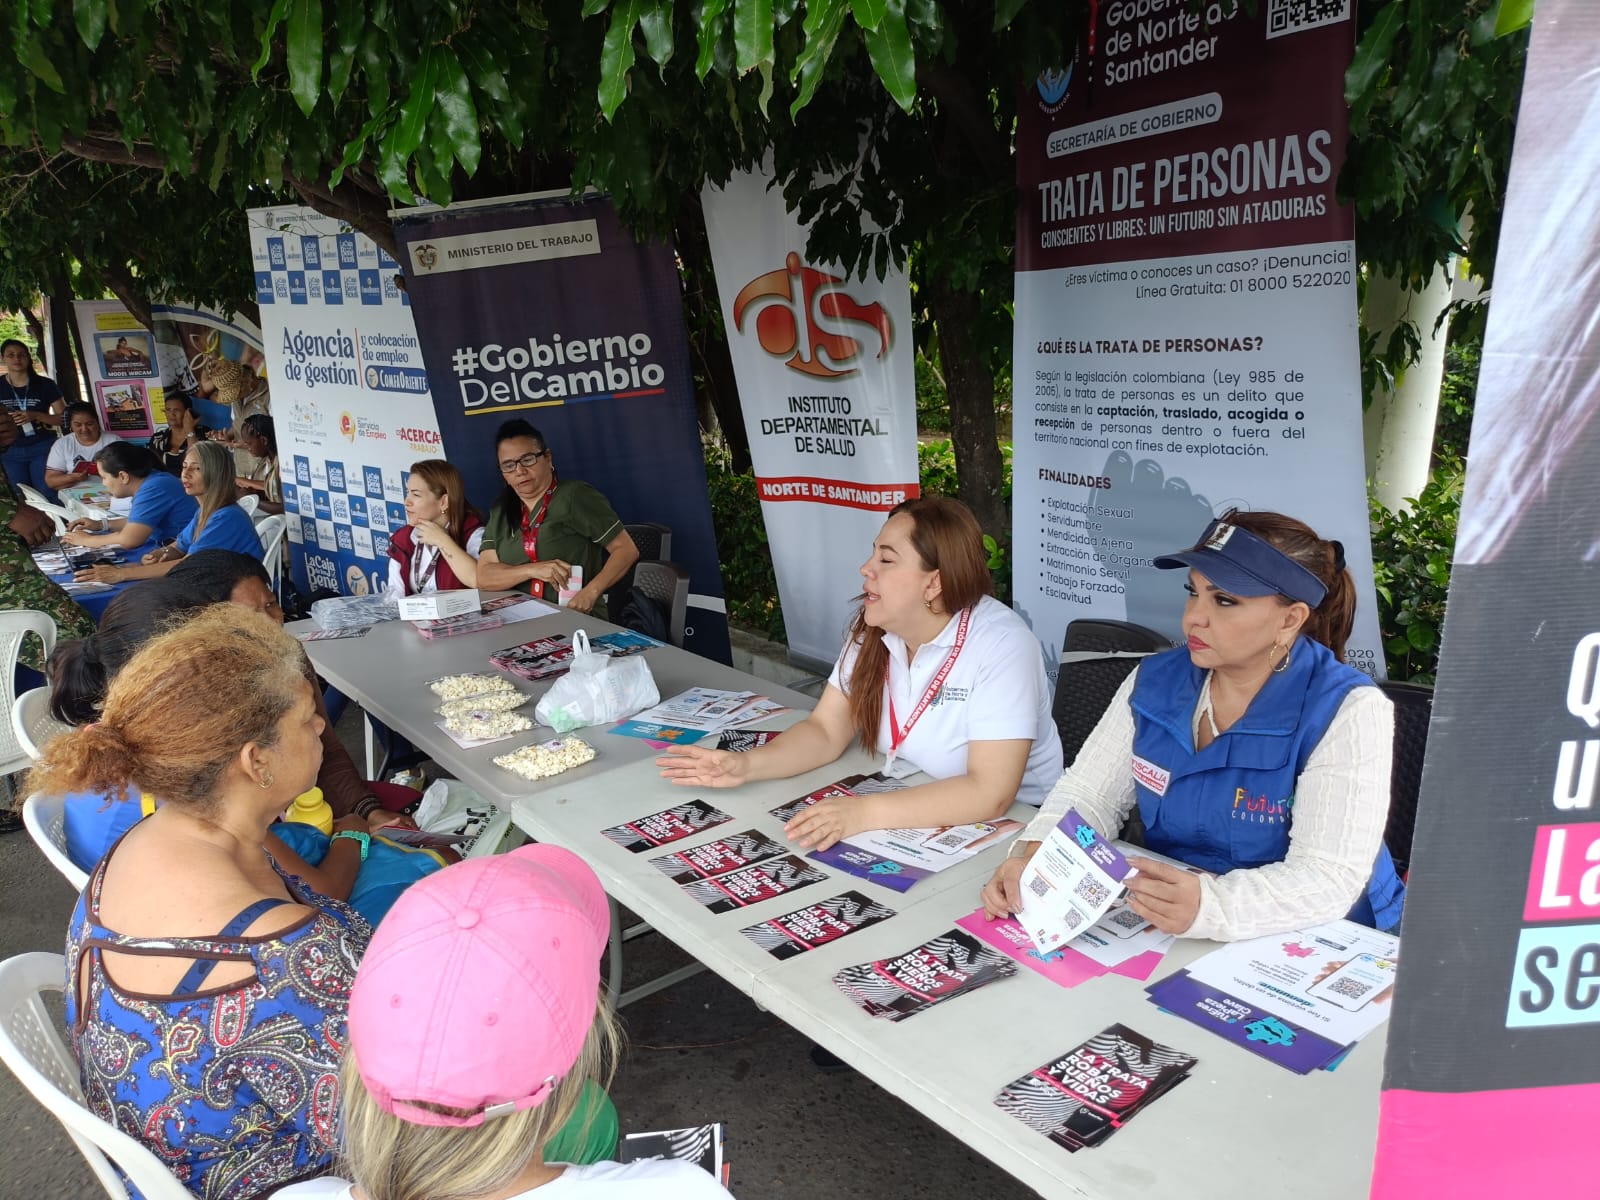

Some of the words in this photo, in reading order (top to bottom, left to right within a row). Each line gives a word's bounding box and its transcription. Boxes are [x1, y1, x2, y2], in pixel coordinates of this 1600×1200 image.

[1105, 31, 1132, 56] de
[1137, 9, 1200, 47] Norte
[1105, 36, 1218, 86] Santander
[1050, 126, 1116, 154] SECRETARÍA
[1120, 122, 1137, 136] DE
[1141, 103, 1217, 132] GOBIERNO
[1039, 171, 1104, 223] TRATA
[1112, 162, 1146, 212] DE
[1154, 129, 1332, 207] PERSONAS
[1041, 219, 1096, 249] CONSCIENTES
[1098, 221, 1105, 241] Y
[1107, 217, 1146, 240] LIBRES:
[1150, 215, 1164, 235] UN
[1168, 208, 1214, 233] FUTURO
[1217, 206, 1238, 227] SIN
[1243, 194, 1326, 225] ATADURAS
[448, 242, 514, 259] MINISTERIO
[516, 239, 538, 251] DEL
[540, 232, 593, 249] TRABAJO
[1065, 273, 1087, 287] ¿Eres
[1089, 268, 1128, 284] víctima
[1130, 271, 1138, 280] o
[1141, 265, 1192, 279] conoces
[1195, 264, 1212, 275] un
[1216, 257, 1259, 273] caso?
[1263, 250, 1351, 273] ¡Denuncia!
[1136, 285, 1167, 299] Línea
[1170, 282, 1226, 297] Gratuita:
[1230, 279, 1244, 293] 01
[1247, 275, 1287, 292] 8000
[1292, 271, 1351, 288] 522020
[283, 326, 355, 363] Agencia
[360, 334, 367, 348] y
[368, 332, 417, 348] colocación
[1037, 337, 1064, 354] ¿QUÉ
[1065, 341, 1076, 354] ES
[1079, 341, 1093, 354] LA
[1096, 340, 1138, 353] TRATA
[1143, 340, 1161, 353] DE
[1165, 336, 1263, 353] PERSONAS?
[362, 349, 374, 361] de
[375, 350, 409, 365] empleo
[452, 333, 651, 377] #Gobierno
[285, 359, 301, 381] de
[305, 361, 359, 388] gestión
[459, 357, 665, 408] DelCambio
[1035, 370, 1061, 384] Según
[1064, 371, 1072, 381] la
[1075, 371, 1127, 385] legislación
[1132, 371, 1205, 383] colombiana
[1213, 369, 1241, 387] (Ley
[1248, 371, 1276, 383] 985
[1284, 369, 1304, 383] de
[788, 396, 851, 414] INSTITUTO
[1063, 387, 1071, 398] la
[1075, 388, 1097, 399] trata
[1101, 388, 1115, 399] de
[1121, 390, 1175, 402] personas
[1181, 391, 1196, 401] es
[1203, 391, 1220, 401] un
[1227, 389, 1267, 402] delito
[1275, 391, 1304, 406] que
[1034, 402, 1068, 413] consiste
[1070, 404, 1081, 414] en
[1084, 404, 1093, 415] la
[1097, 405, 1158, 419] captación,
[1162, 407, 1222, 421] traslado,
[1227, 407, 1289, 424] acogida
[1295, 411, 1305, 420] o
[400, 427, 440, 445] ACERCA
[760, 416, 888, 436] DEPARTAMENTAL
[1034, 418, 1075, 431] recepción
[1081, 421, 1093, 431] de
[1100, 423, 1152, 435] personas
[1161, 424, 1203, 436] dentro
[1213, 427, 1222, 437] o
[1232, 425, 1270, 438] fuera
[1282, 427, 1305, 439] del
[795, 436, 814, 453] DE
[816, 437, 856, 457] SALUD
[1034, 432, 1068, 445] territorio
[1069, 436, 1109, 449] nacional
[1112, 440, 1133, 450] con
[1136, 439, 1163, 452] fines
[1166, 441, 1183, 453] de
[1185, 442, 1268, 457] explotación.
[1039, 468, 1112, 490] FINALIDADES
[763, 482, 809, 497] NORTE
[812, 483, 826, 498] DE
[828, 484, 906, 505] SANTANDER
[1047, 497, 1095, 515] Explotación
[1097, 505, 1134, 519] Sexual
[1047, 512, 1102, 531] Servidumbre
[1047, 527, 1097, 546] Mendicidad
[1101, 537, 1133, 550] Ajena
[1046, 542, 1090, 561] Extracción
[1092, 551, 1107, 562] de
[1109, 551, 1154, 568] Órgano
[1046, 557, 1097, 576] Matrimonio
[1099, 566, 1130, 580] Servil
[1046, 571, 1078, 590] Trabajo
[1080, 579, 1125, 594] Forzado
[1045, 586, 1092, 605] Esclavitud
[724, 881, 751, 899] VIDAS
[737, 871, 761, 888] ROBA
[747, 868, 761, 877] LA
[758, 875, 785, 893] TRATA
[796, 909, 825, 928] ROBA
[806, 906, 822, 916] LA
[820, 913, 851, 933] TRATA
[785, 921, 815, 940] VIDAS
[902, 953, 938, 978] ROBA
[912, 949, 930, 963] LA
[930, 960, 968, 983] TRATA
[885, 963, 898, 972] Y
[895, 970, 932, 992] VIDAS
[1065, 1054, 1110, 1084] ROBA
[1075, 1048, 1097, 1065] LA
[1099, 1061, 1149, 1090] TRATA
[1047, 1065, 1062, 1076] Y
[1061, 1074, 1110, 1104] VIDAS
